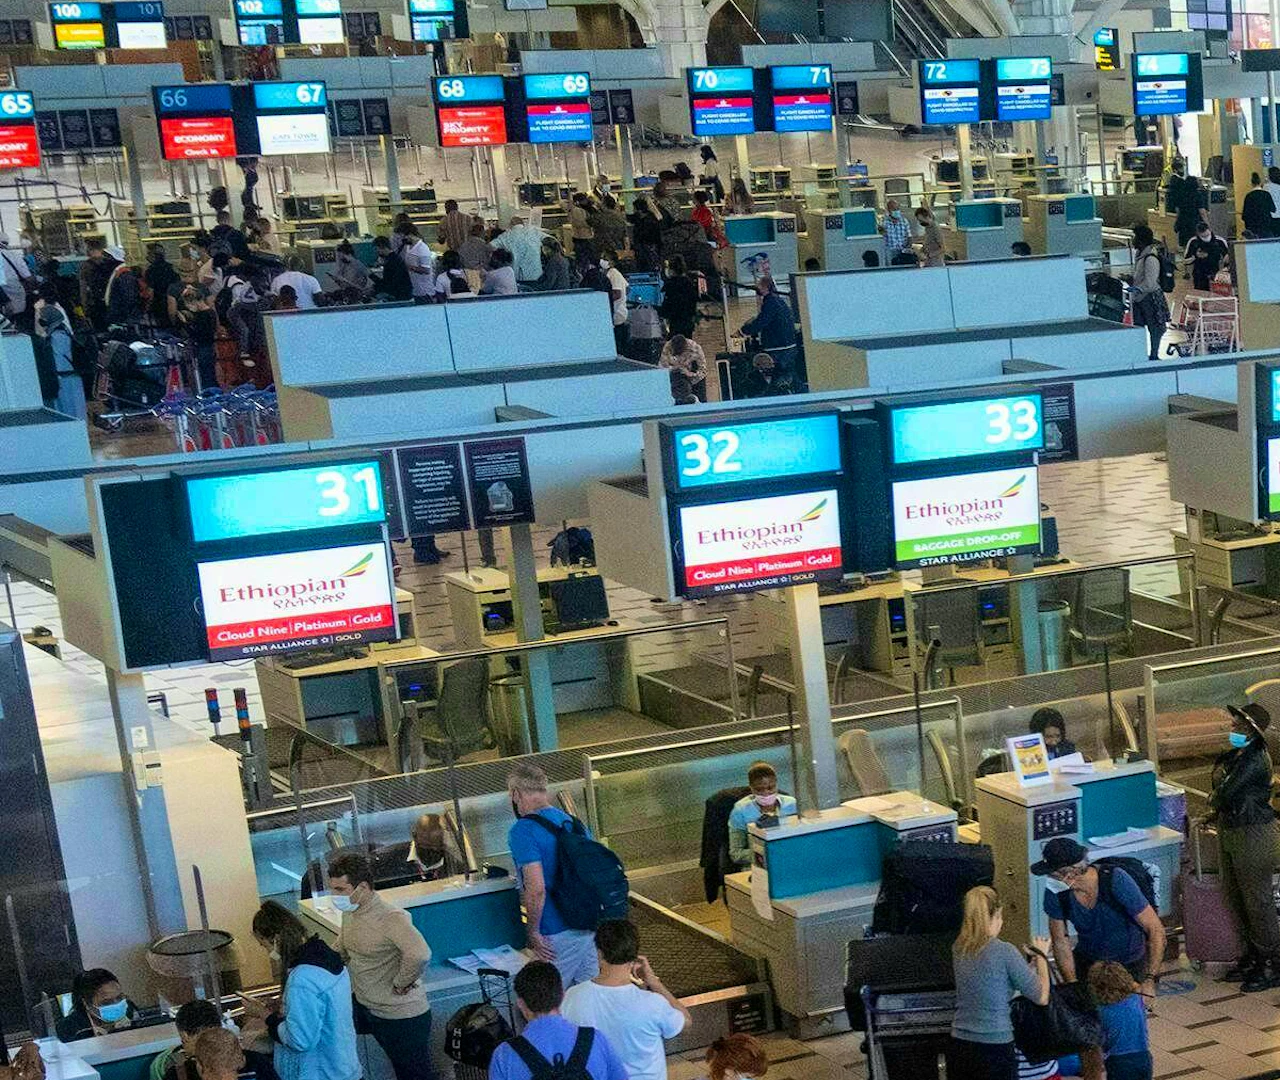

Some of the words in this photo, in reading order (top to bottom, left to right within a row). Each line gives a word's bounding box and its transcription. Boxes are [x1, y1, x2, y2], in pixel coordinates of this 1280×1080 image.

[53, 3, 81, 17] 100
[138, 3, 161, 15] 101
[810, 67, 831, 84] 71
[925, 63, 947, 79] 72
[1030, 59, 1051, 76] 73
[439, 80, 465, 98] 68
[563, 75, 588, 94] 69
[693, 70, 717, 88] 70
[2, 94, 32, 114] 65
[161, 90, 188, 107] 66
[296, 84, 323, 104] 67
[174, 132, 226, 145] ECONOMY
[985, 400, 1039, 445] 33
[680, 431, 742, 477] 32
[316, 467, 380, 517] 31
[905, 496, 1004, 522] Ethiopian
[697, 521, 804, 547] Ethiopian
[913, 538, 965, 554] BAGGAGE
[966, 531, 1022, 546] DROP-OFF
[694, 567, 726, 581] Cloud
[727, 564, 754, 577] Nine
[758, 558, 802, 573] Platinum
[807, 554, 832, 567] Gold
[919, 556, 947, 568] STAR
[947, 549, 1004, 564] ALLIANCE
[219, 577, 347, 603] Ethiopian
[714, 583, 736, 592] STAR
[736, 578, 779, 590] ALLIANCE
[792, 572, 815, 581] GOLD
[217, 628, 255, 643] Cloud
[257, 624, 288, 637] Nine
[293, 618, 347, 633] Platinum
[352, 612, 382, 626] Gold
[242, 645, 268, 655] STAR
[269, 638, 318, 652] ALLIANCE
[335, 632, 362, 642] GOLD
